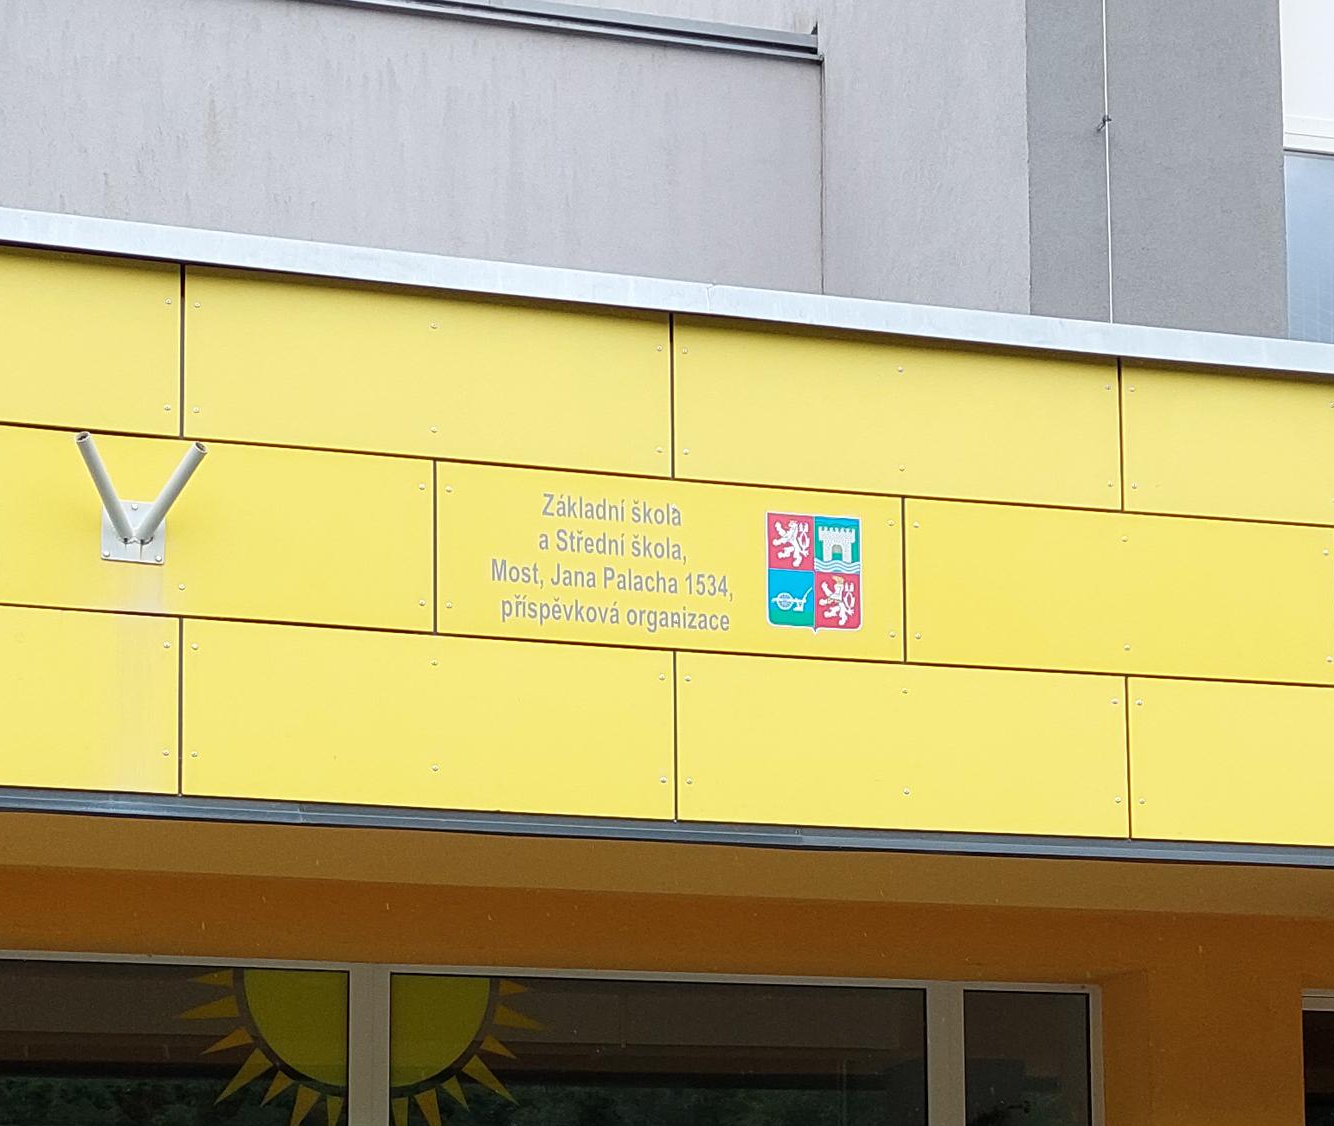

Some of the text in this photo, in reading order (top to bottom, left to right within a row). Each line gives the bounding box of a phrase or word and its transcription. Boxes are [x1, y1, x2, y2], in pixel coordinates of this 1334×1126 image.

[541, 492, 682, 527] Základní škola
[538, 528, 688, 565] a Střední škola,
[490, 557, 735, 602] Most, Jana Palacha 1534,
[500, 594, 731, 634] příspěvková organizace
